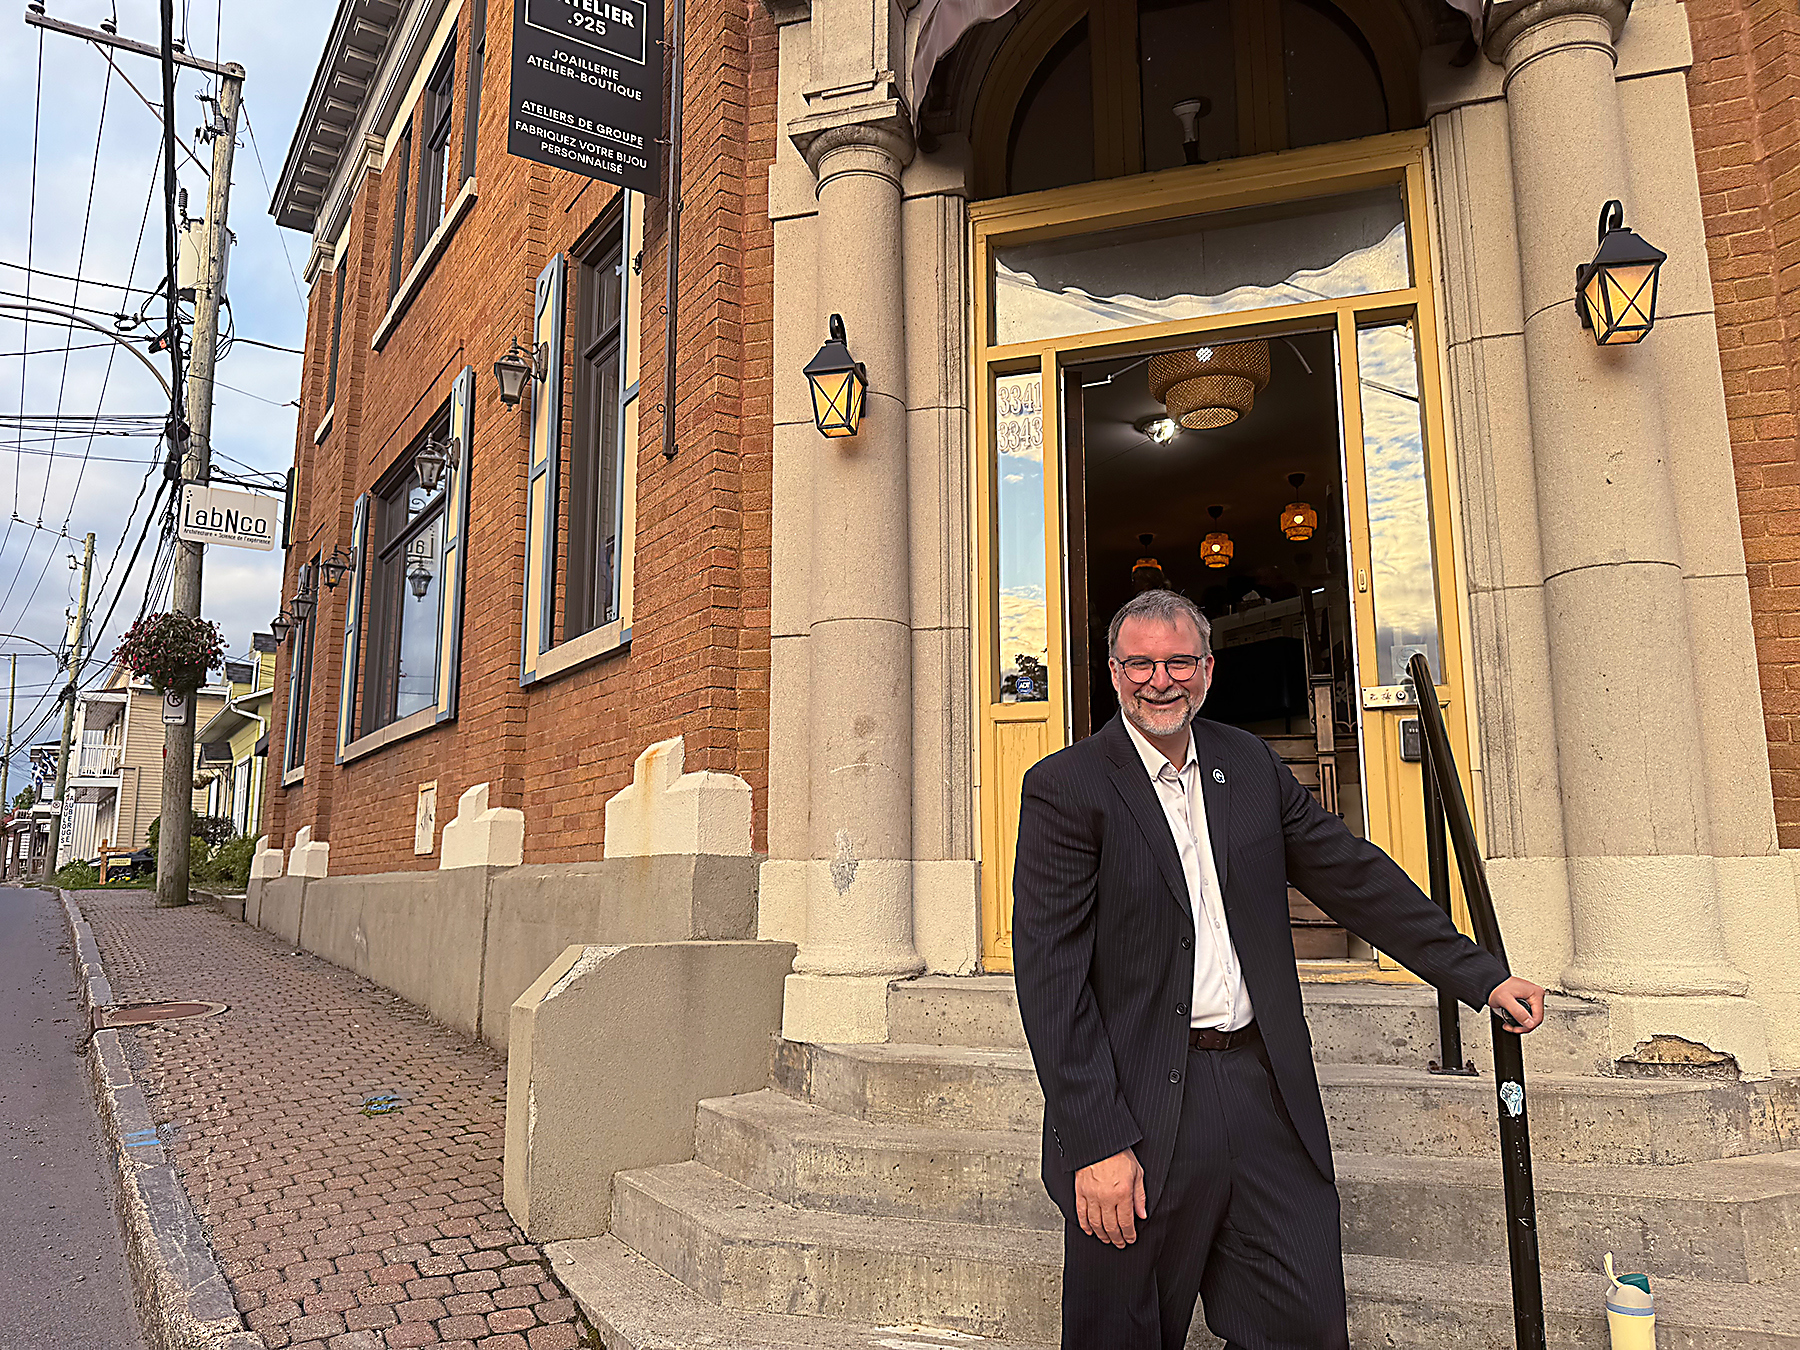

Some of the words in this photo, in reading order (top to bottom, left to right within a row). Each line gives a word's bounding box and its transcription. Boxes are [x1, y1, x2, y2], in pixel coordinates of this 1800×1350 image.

[567, 12, 607, 36] .925
[527, 55, 642, 101] ATELIER-BOUTIQUE
[552, 50, 620, 81] JOAILLERIE
[521, 101, 575, 124] ATELIERS
[578, 117, 593, 131] DE
[596, 124, 644, 147] GROUPE
[515, 121, 577, 148] FABRIQUEZ
[578, 139, 614, 159] VOTRE
[616, 153, 647, 169] BIJOU
[540, 142, 623, 175] PERSONNALISÉ
[998, 382, 1042, 416] 3341
[998, 417, 1043, 453] 3343
[183, 528, 213, 537] Architecture
[218, 533, 236, 541] Science
[184, 503, 267, 534] LabNco
[66, 795, 74, 843] AUBERGE
